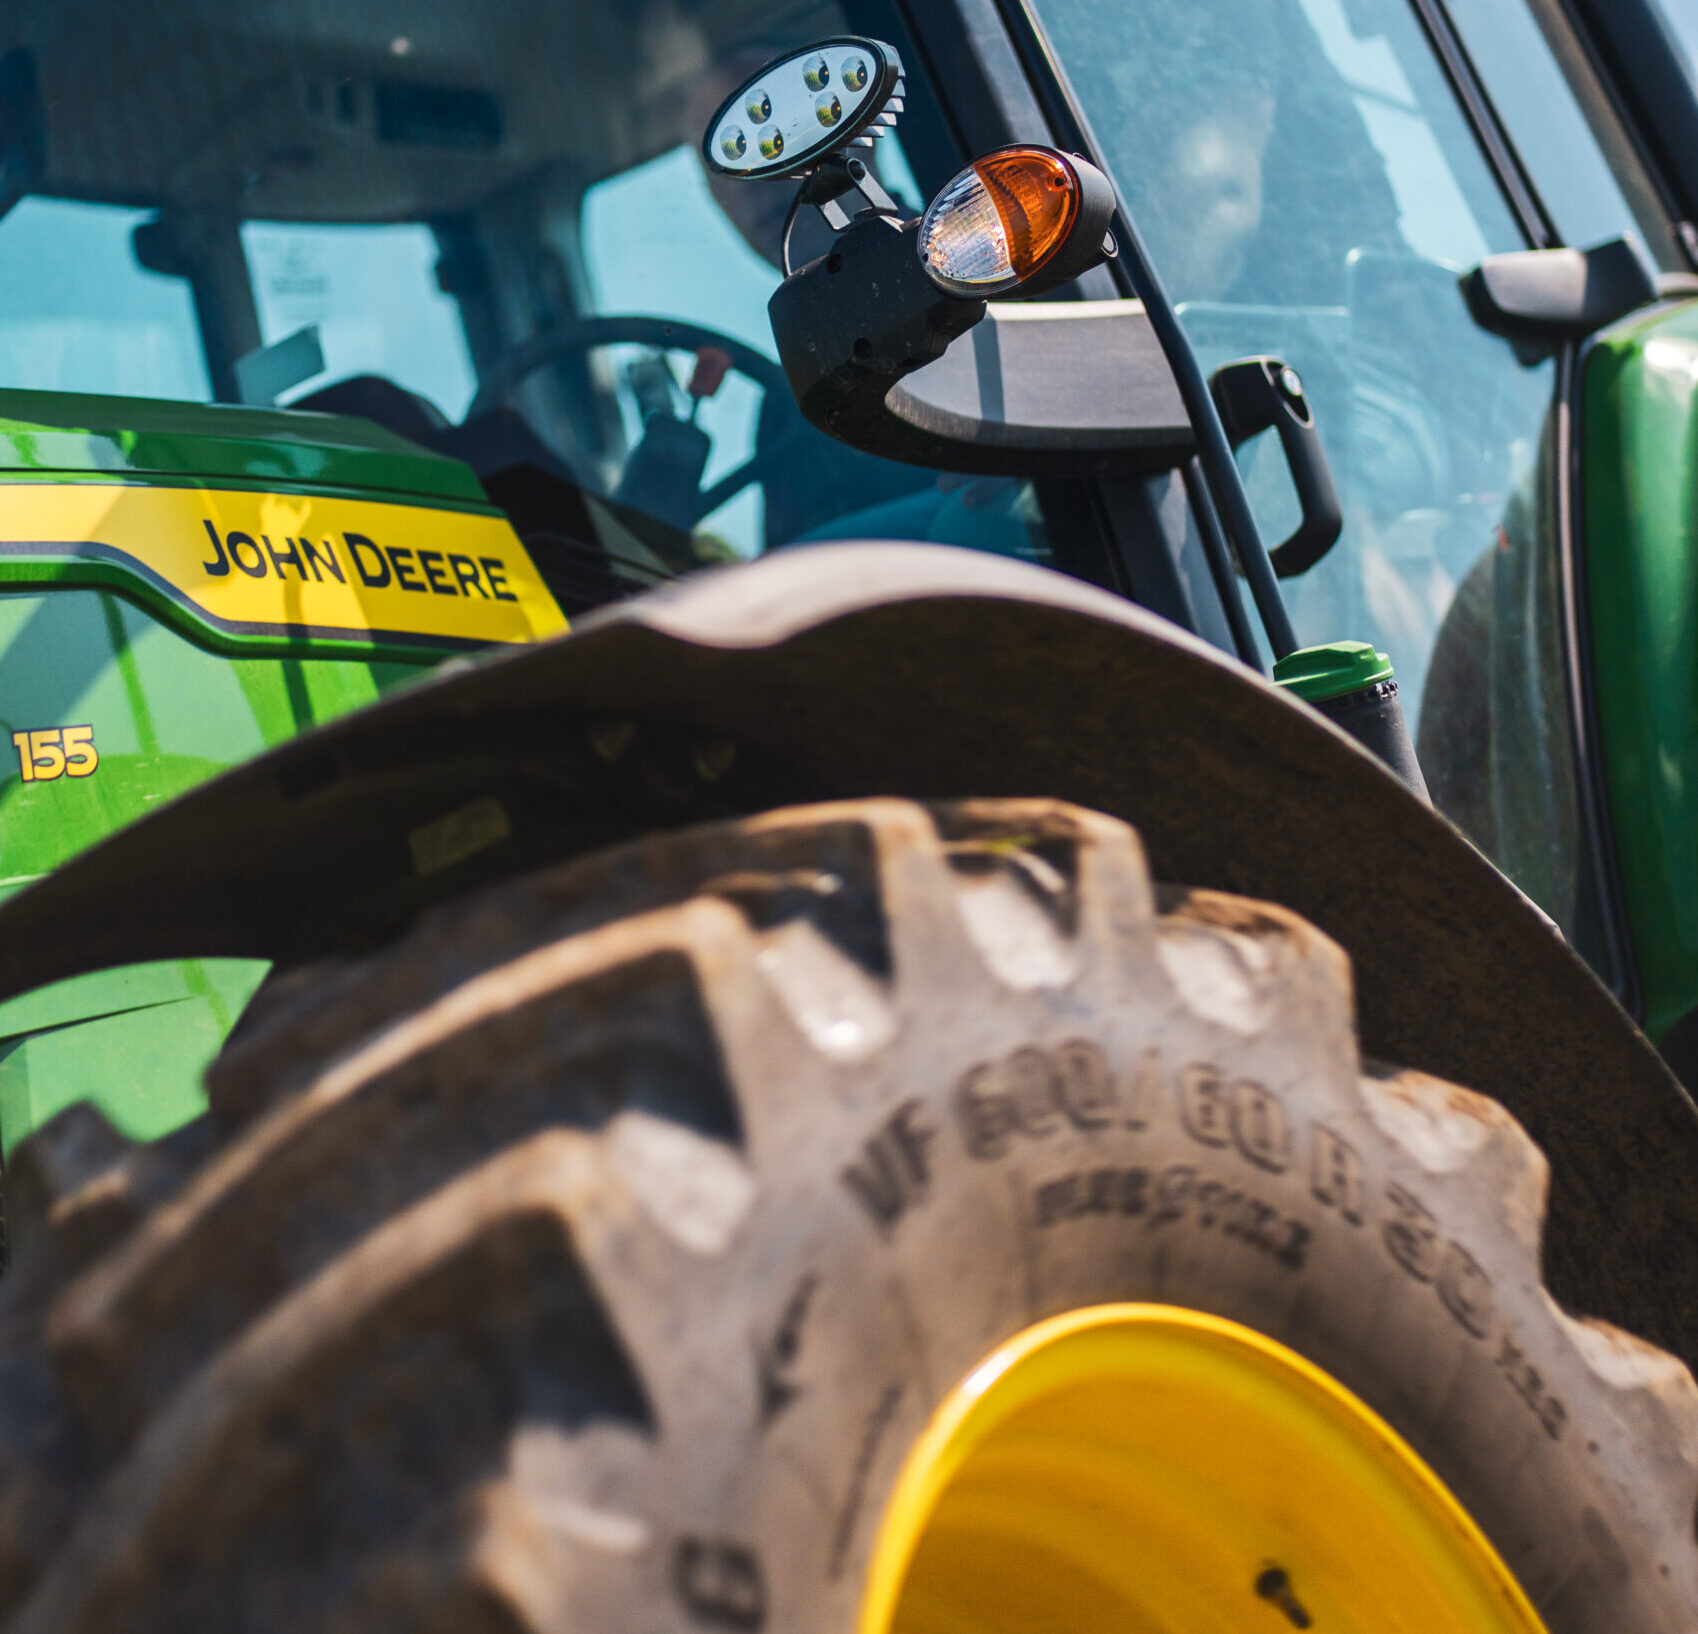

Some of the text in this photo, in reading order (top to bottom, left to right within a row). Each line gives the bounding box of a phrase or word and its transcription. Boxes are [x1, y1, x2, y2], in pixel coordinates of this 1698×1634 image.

[202, 519, 519, 603] JOHN DEERE
[12, 723, 99, 784] 155
[840, 1097, 938, 1243] VF
